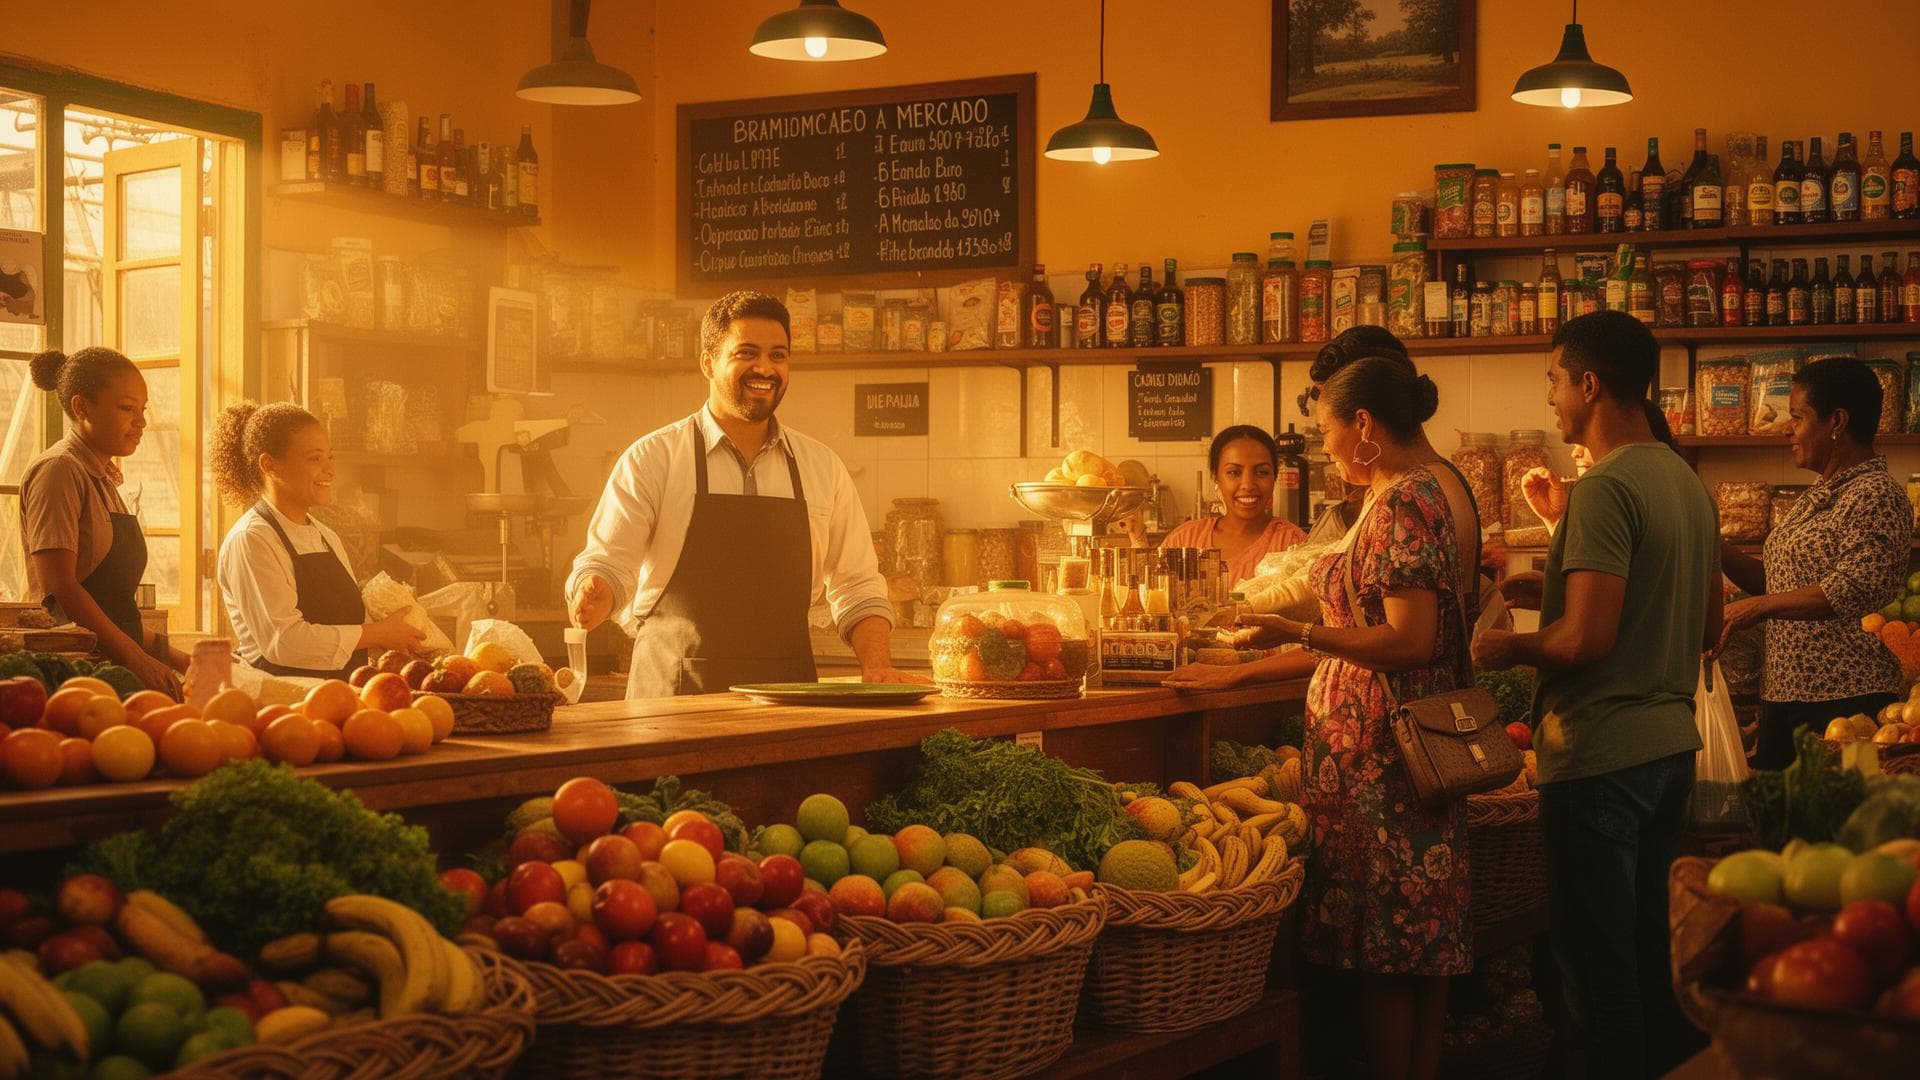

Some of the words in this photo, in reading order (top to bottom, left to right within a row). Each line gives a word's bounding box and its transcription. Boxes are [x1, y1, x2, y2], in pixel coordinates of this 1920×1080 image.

[876, 109, 887, 130] A
[897, 98, 989, 130] MERCADO
[878, 213, 889, 233] A
